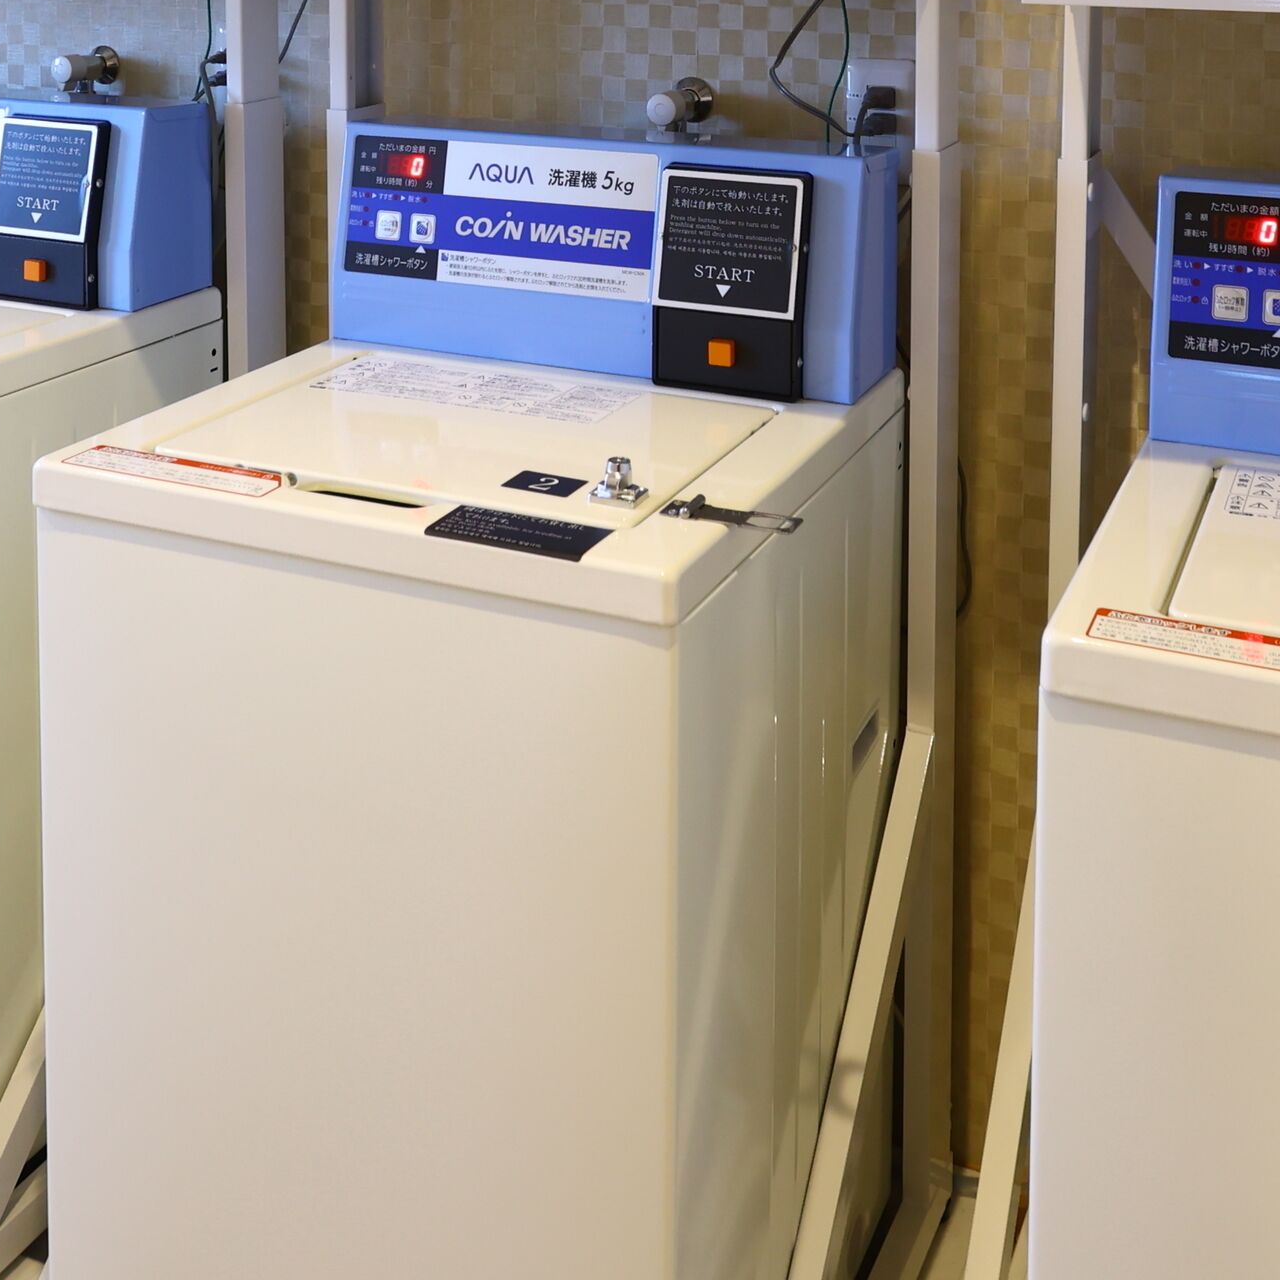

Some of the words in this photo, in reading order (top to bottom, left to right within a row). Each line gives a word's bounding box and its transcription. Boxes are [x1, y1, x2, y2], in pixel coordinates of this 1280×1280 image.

[379, 143, 426, 153] ただいまの金額
[428, 146, 436, 155] 円
[410, 158, 424, 176] 0
[426, 180, 433, 189] 分
[469, 163, 535, 185] AQUA
[547, 168, 598, 190] 洗濯機
[601, 170, 635, 196] 5kg
[16, 196, 60, 211] START
[673, 185, 789, 204] 下のボタンにて始動いたします。
[672, 198, 783, 217] 洗剤は自動で投入いたします。
[1210, 201, 1280, 216] ただいまの金額
[455, 211, 524, 241] COIN
[530, 222, 632, 251] WASHER
[1184, 228, 1208, 238] 運転中
[1259, 220, 1278, 243] 0
[355, 252, 428, 270] 洗濯槽シャワーボタン
[1214, 264, 1234, 272] すすぎ
[694, 264, 755, 283] START
[530, 476, 556, 492] 2
